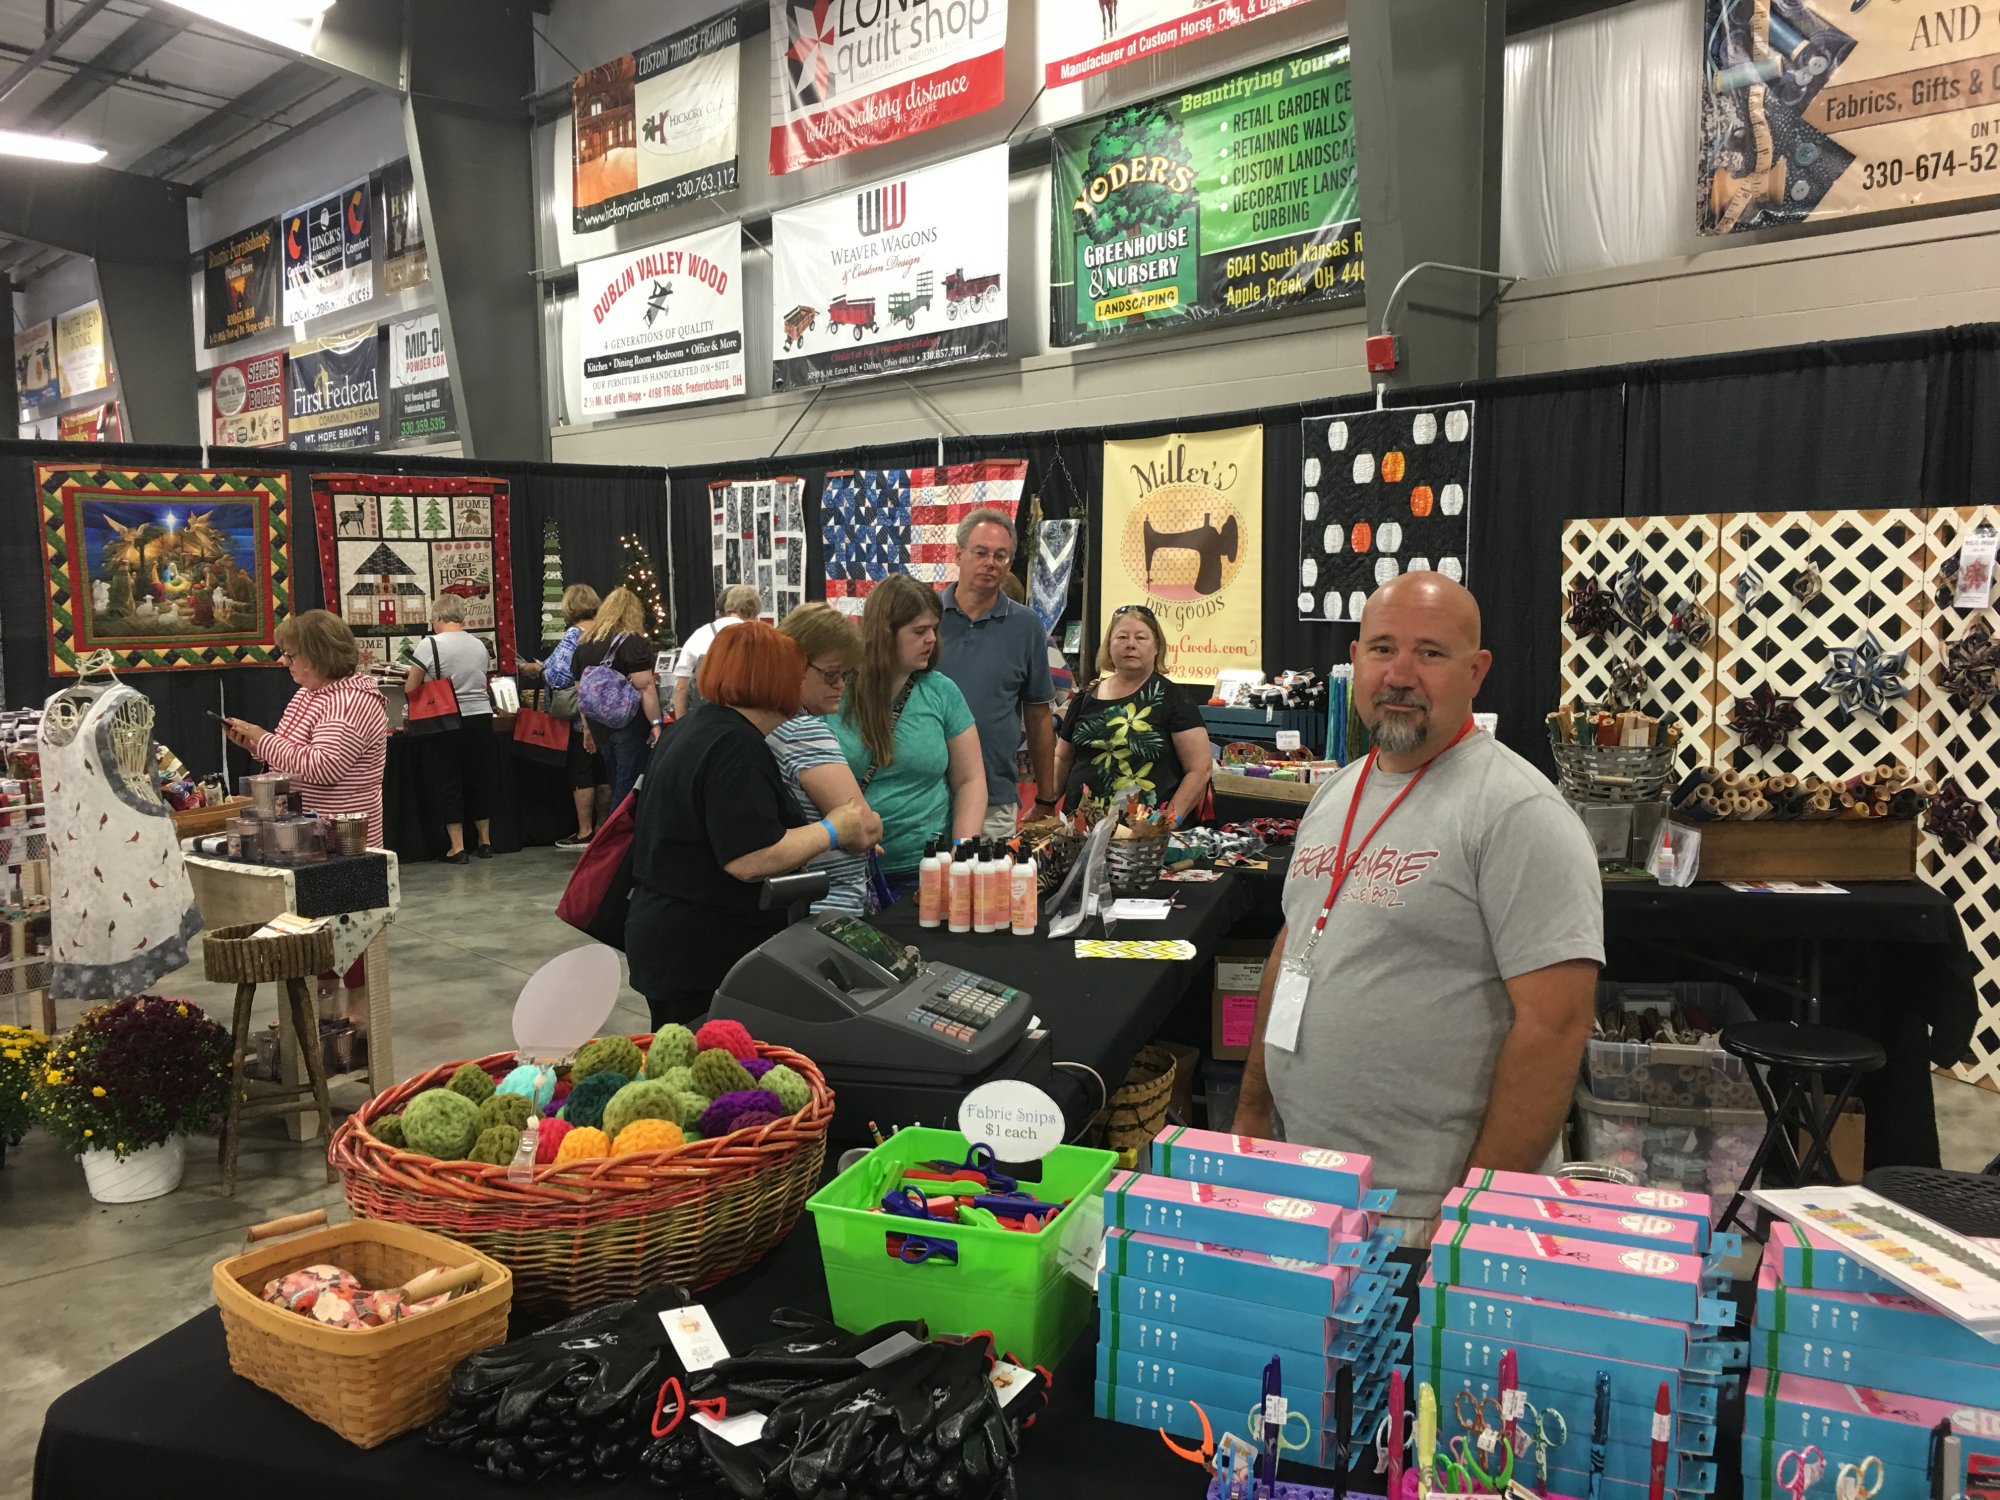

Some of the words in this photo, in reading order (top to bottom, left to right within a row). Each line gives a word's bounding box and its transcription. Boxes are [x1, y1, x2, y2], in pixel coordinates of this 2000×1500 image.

[839, 0, 927, 37] LO
[1909, 4, 1981, 51] AND
[639, 46, 669, 76] CUSTOM
[670, 33, 698, 62] TIMBER
[700, 17, 737, 51] FRAMING
[837, 18, 901, 83] quilt
[910, 0, 990, 49] shop
[908, 46, 938, 62] NOTIONS
[1060, 48, 1125, 80] Manufacturer
[1127, 42, 1137, 56] of
[1139, 28, 1178, 53] Custom
[1180, 18, 1216, 39] Horse,
[1180, 68, 1284, 113] Beautifying
[1288, 54, 1334, 79] Your
[1826, 90, 1902, 122] Fabrics,
[1911, 76, 1961, 107] Gifts
[1968, 69, 1984, 95] &
[669, 104, 703, 128] HICKORY
[806, 113, 847, 144] within
[849, 94, 902, 130] walking
[905, 75, 970, 111] distance
[881, 116, 891, 129] OF
[910, 102, 938, 119] SQUARE
[1233, 102, 1274, 135] RETAIL
[1278, 86, 1330, 120] GARDEN
[1335, 80, 1352, 104] CE
[1232, 124, 1299, 160] RETAINING
[1303, 110, 1347, 141] WALLS
[1971, 121, 1989, 138] ON
[1233, 158, 1284, 187] CUSTOM
[1862, 142, 1999, 191] 330-674-52
[1073, 155, 1194, 218] YODER'S
[1233, 181, 1309, 214] DECORATIVE
[584, 189, 670, 227] www.hickorycircle.com
[1252, 202, 1310, 232] CURBING
[311, 227, 342, 251] ZINCK'S
[346, 237, 370, 255] Comfort
[831, 242, 878, 267] WEAVER
[881, 227, 938, 253] WAGONS
[1084, 226, 1189, 269] GREENHOUSE
[851, 261, 884, 281] Custom
[886, 255, 921, 279] Design
[1226, 258, 1256, 280] 6041
[1260, 249, 1297, 273] South
[1302, 239, 1349, 263] Kansas
[593, 266, 635, 325] DUBLIN
[636, 251, 684, 281] VALLEY
[688, 252, 728, 296] WOOD
[1088, 263, 1104, 299] &
[1106, 255, 1179, 289] NURSERY
[1226, 283, 1262, 307] Apple
[1267, 275, 1308, 297] Creek,
[1314, 265, 1334, 289] OH
[1098, 291, 1175, 318] LANDSCAPING
[406, 327, 444, 361] MID-O
[611, 331, 663, 349] GENERATIONS
[665, 328, 676, 340] OF
[677, 320, 715, 340] QUALITY
[248, 356, 280, 384] SHOES
[406, 356, 431, 374] POWDER
[587, 360, 609, 373] Kitchen
[613, 356, 634, 370] Dining
[634, 354, 652, 366] Room
[656, 348, 684, 362] Bedroom
[691, 343, 711, 356] Office
[711, 341, 719, 351] &
[720, 338, 737, 350] More
[884, 357, 898, 368] Ohio
[921, 344, 967, 362] 330.857.7811
[592, 379, 606, 391] OUR
[607, 374, 640, 389] FURNITURE
[650, 366, 698, 381] HANDCRAFTED
[700, 359, 730, 374] ON-SITE
[604, 393, 612, 405] NE
[628, 390, 641, 404] Hope
[648, 385, 662, 399] 4198
[663, 384, 671, 396] TR
[685, 377, 731, 395] Fredericksburg,
[732, 374, 743, 387] OH
[248, 383, 281, 410] BOOTS
[293, 386, 324, 416] First
[325, 368, 379, 409] Federal
[319, 408, 358, 427] COMMUNITY
[359, 405, 379, 420] BANK
[401, 416, 446, 437] 330.359.5315
[305, 434, 316, 444] MT.
[318, 430, 337, 443] HOPE
[339, 424, 368, 440] BRANCH
[1130, 444, 1237, 498] Miller's
[456, 500, 489, 510] HOME
[440, 567, 478, 586] HOME
[1145, 597, 1171, 619] DRY
[1175, 595, 1225, 632] GOODS
[1168, 665, 1219, 680] 93.9899
[966, 1103, 1012, 1121] Fabric
[1017, 1107, 1057, 1126] Snips
[985, 1123, 1001, 1137] $1
[1004, 1126, 1038, 1140] each
